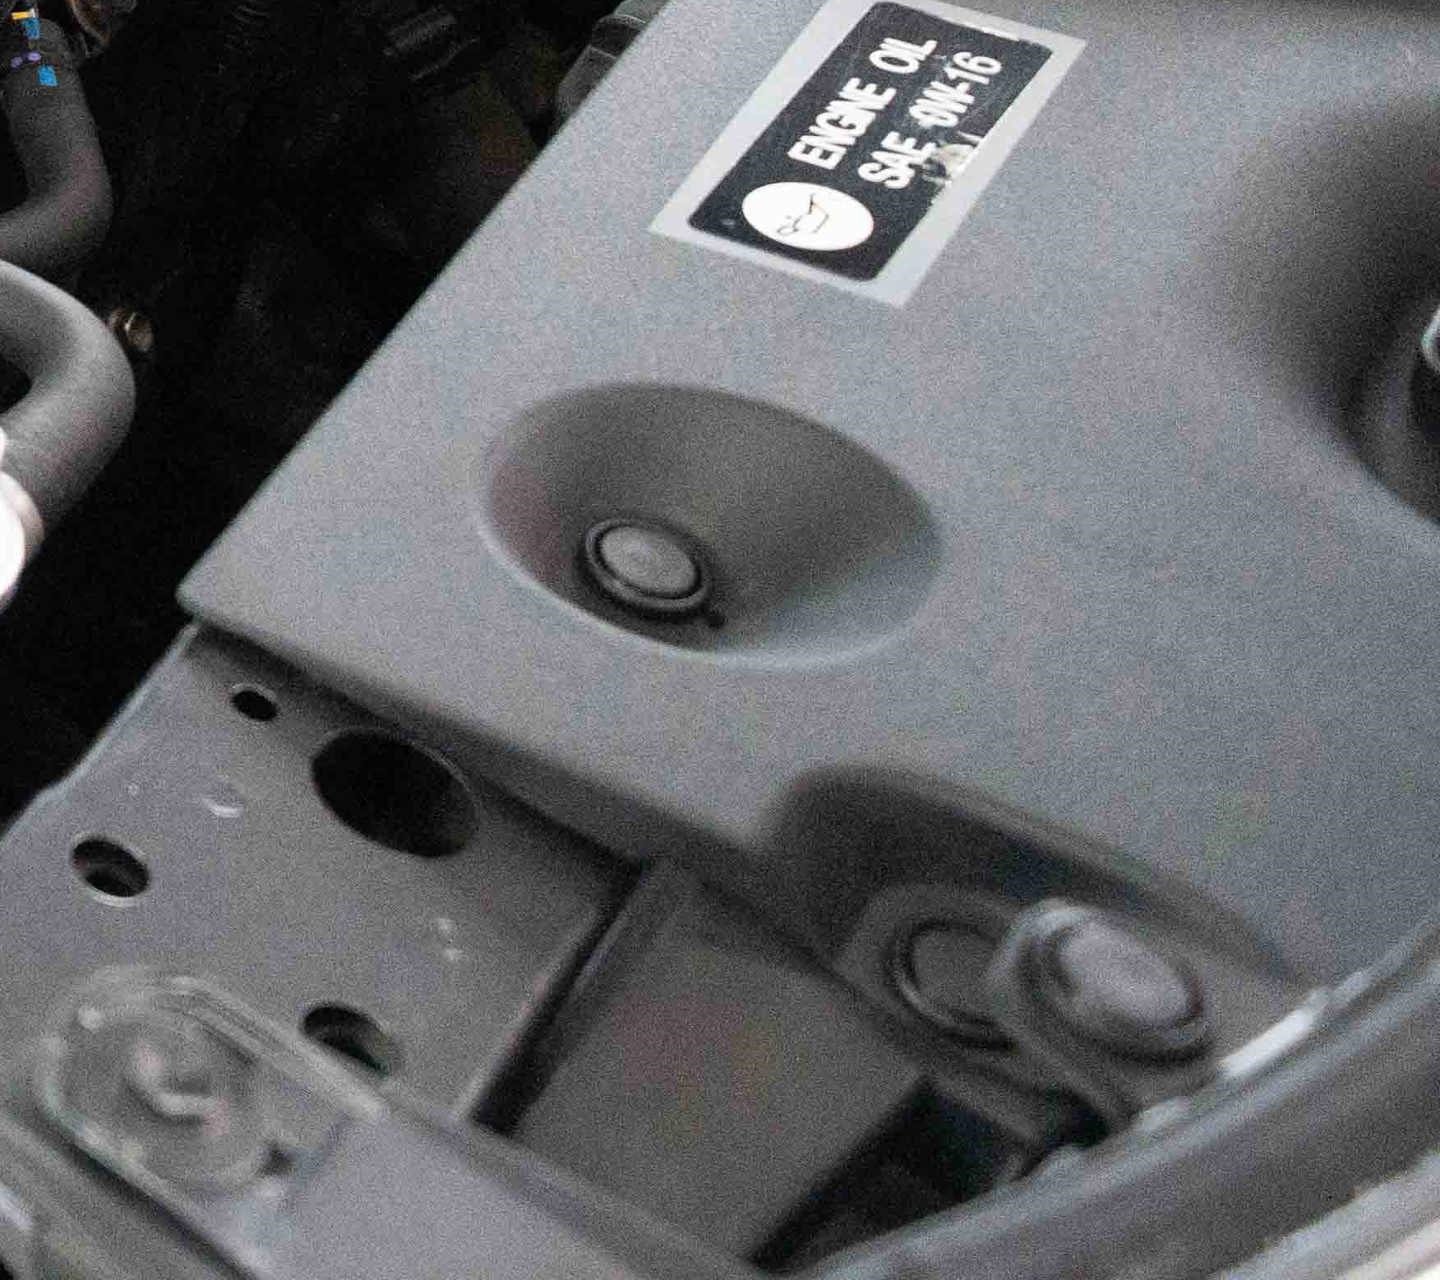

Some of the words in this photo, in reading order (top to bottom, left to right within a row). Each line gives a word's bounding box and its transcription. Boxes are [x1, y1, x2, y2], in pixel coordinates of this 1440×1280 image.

[786, 76, 897, 170] ENGINE
[868, 36, 939, 74] OIL
[857, 130, 938, 190] SAE
[908, 50, 1003, 129] 0W-16
